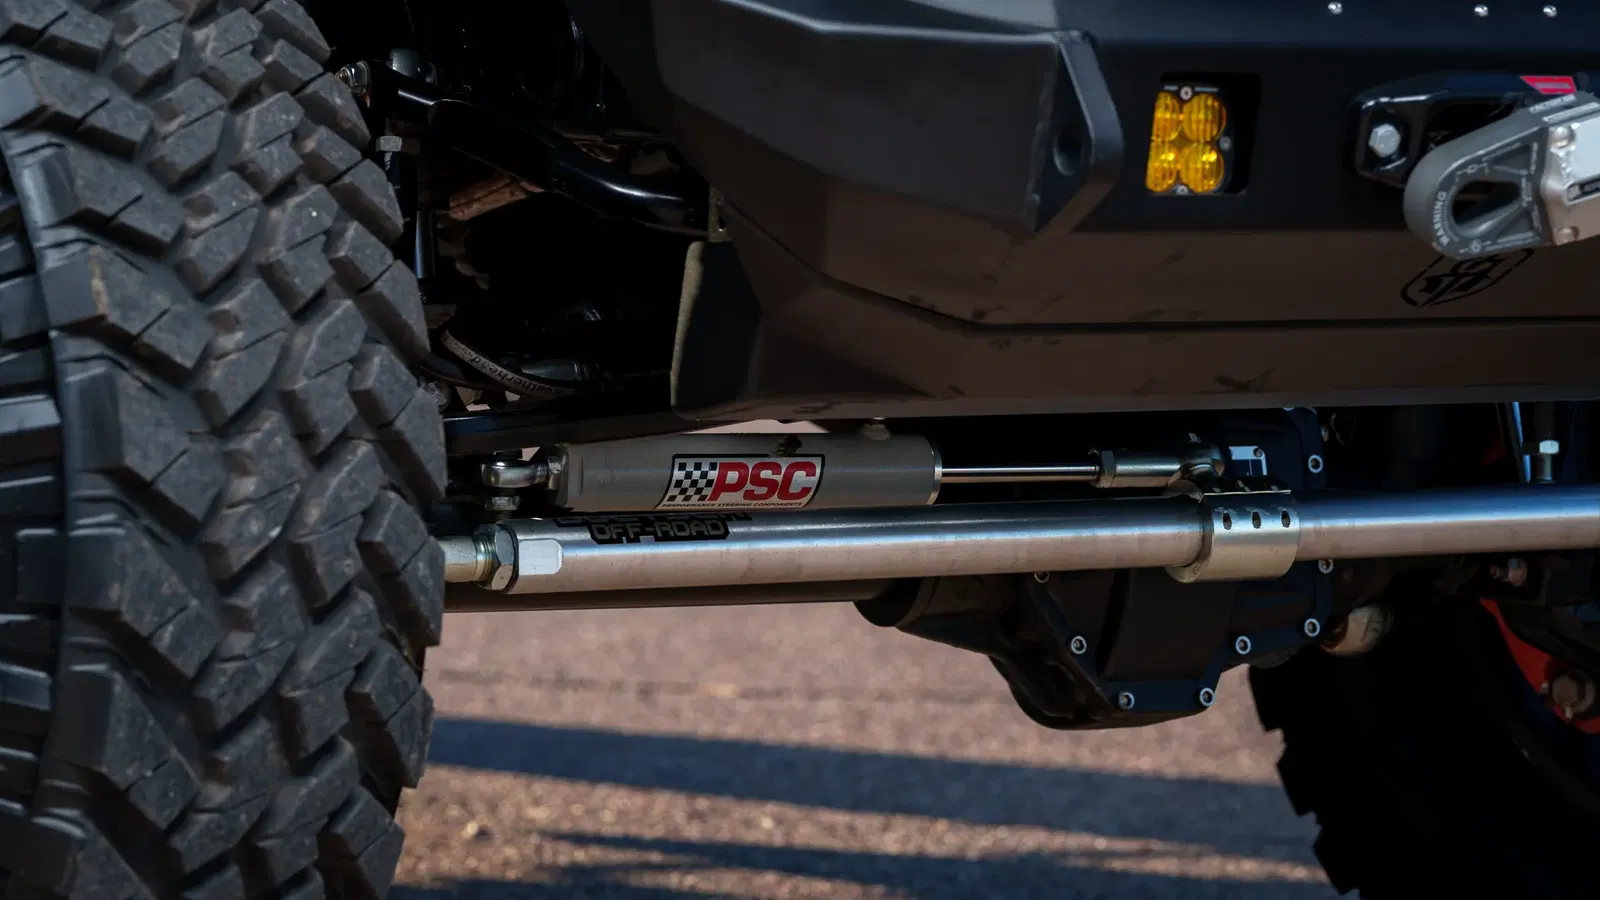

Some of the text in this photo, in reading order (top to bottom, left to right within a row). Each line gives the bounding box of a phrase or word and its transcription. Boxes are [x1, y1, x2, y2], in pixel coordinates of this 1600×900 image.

[1433, 191, 1450, 247] WARNING
[470, 355, 553, 393] eatherhead
[707, 461, 817, 501] PSC
[592, 519, 726, 540] OFF-ROAD
